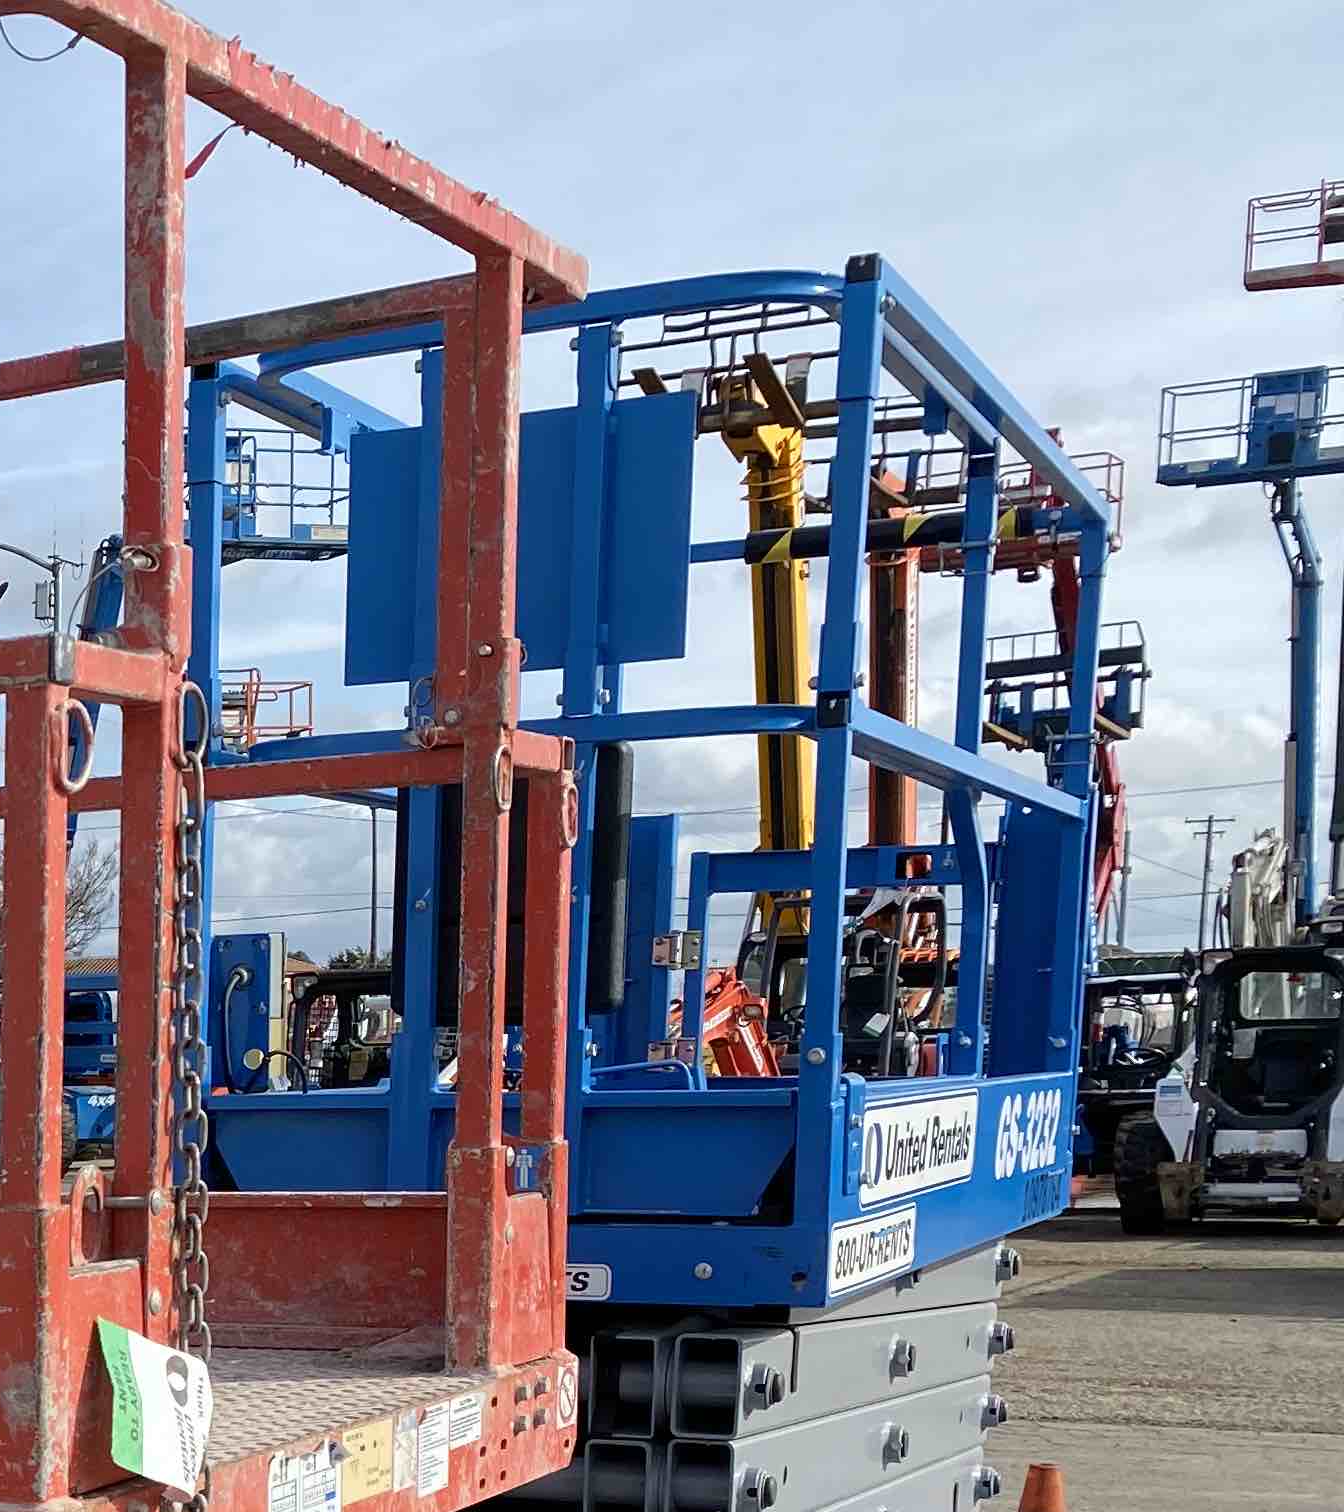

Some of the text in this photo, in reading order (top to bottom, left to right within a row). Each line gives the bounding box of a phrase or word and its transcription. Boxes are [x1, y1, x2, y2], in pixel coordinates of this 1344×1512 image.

[88, 1095, 115, 1107] 4x4
[995, 1088, 1061, 1180] GS-3232
[886, 1112, 971, 1180] United Rentals
